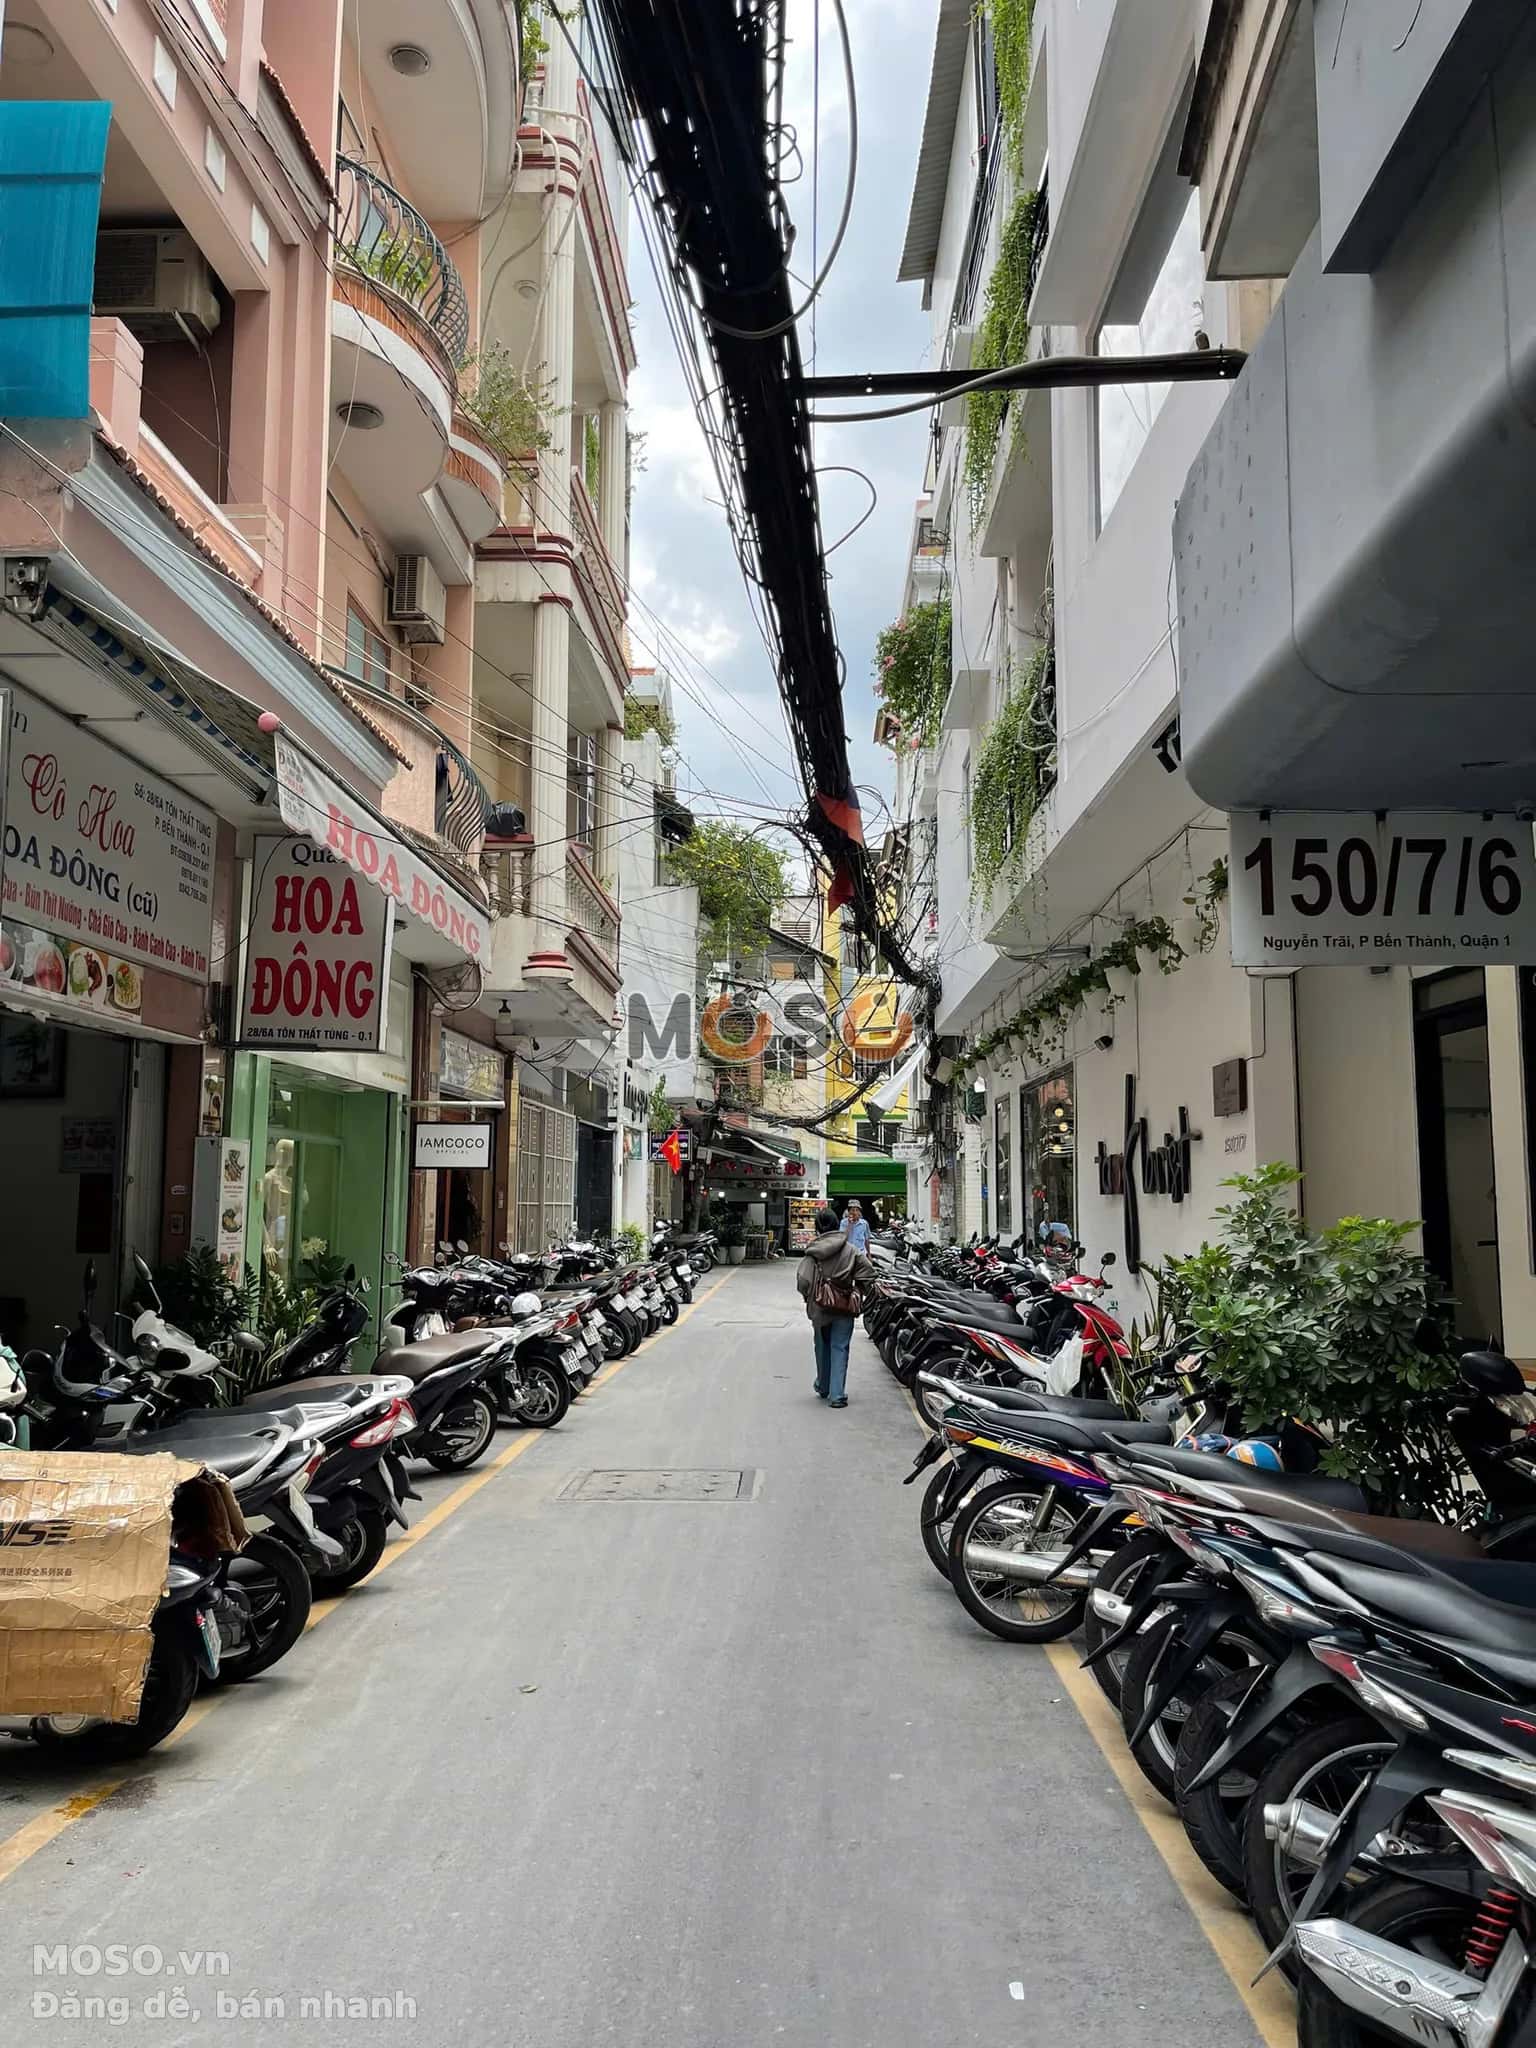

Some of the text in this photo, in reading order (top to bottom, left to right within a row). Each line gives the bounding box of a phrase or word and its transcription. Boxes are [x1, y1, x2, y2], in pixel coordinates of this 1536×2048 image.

[78, 784, 136, 859] Hoa
[4, 825, 41, 869] OA
[49, 844, 120, 903] ĐÔNG
[127, 881, 158, 922] (cũ)
[271, 875, 364, 935] HOA
[326, 803, 481, 955] HOA ĐÔNG
[1245, 835, 1522, 917] 150/7/6
[250, 940, 374, 1019] ĐÔNG
[1263, 933, 1511, 951] Nguyễn Trãi, P Bến Thành, Quận 1
[299, 1026, 321, 1040] THẤT
[420, 1137, 485, 1149] IAMCOCO
